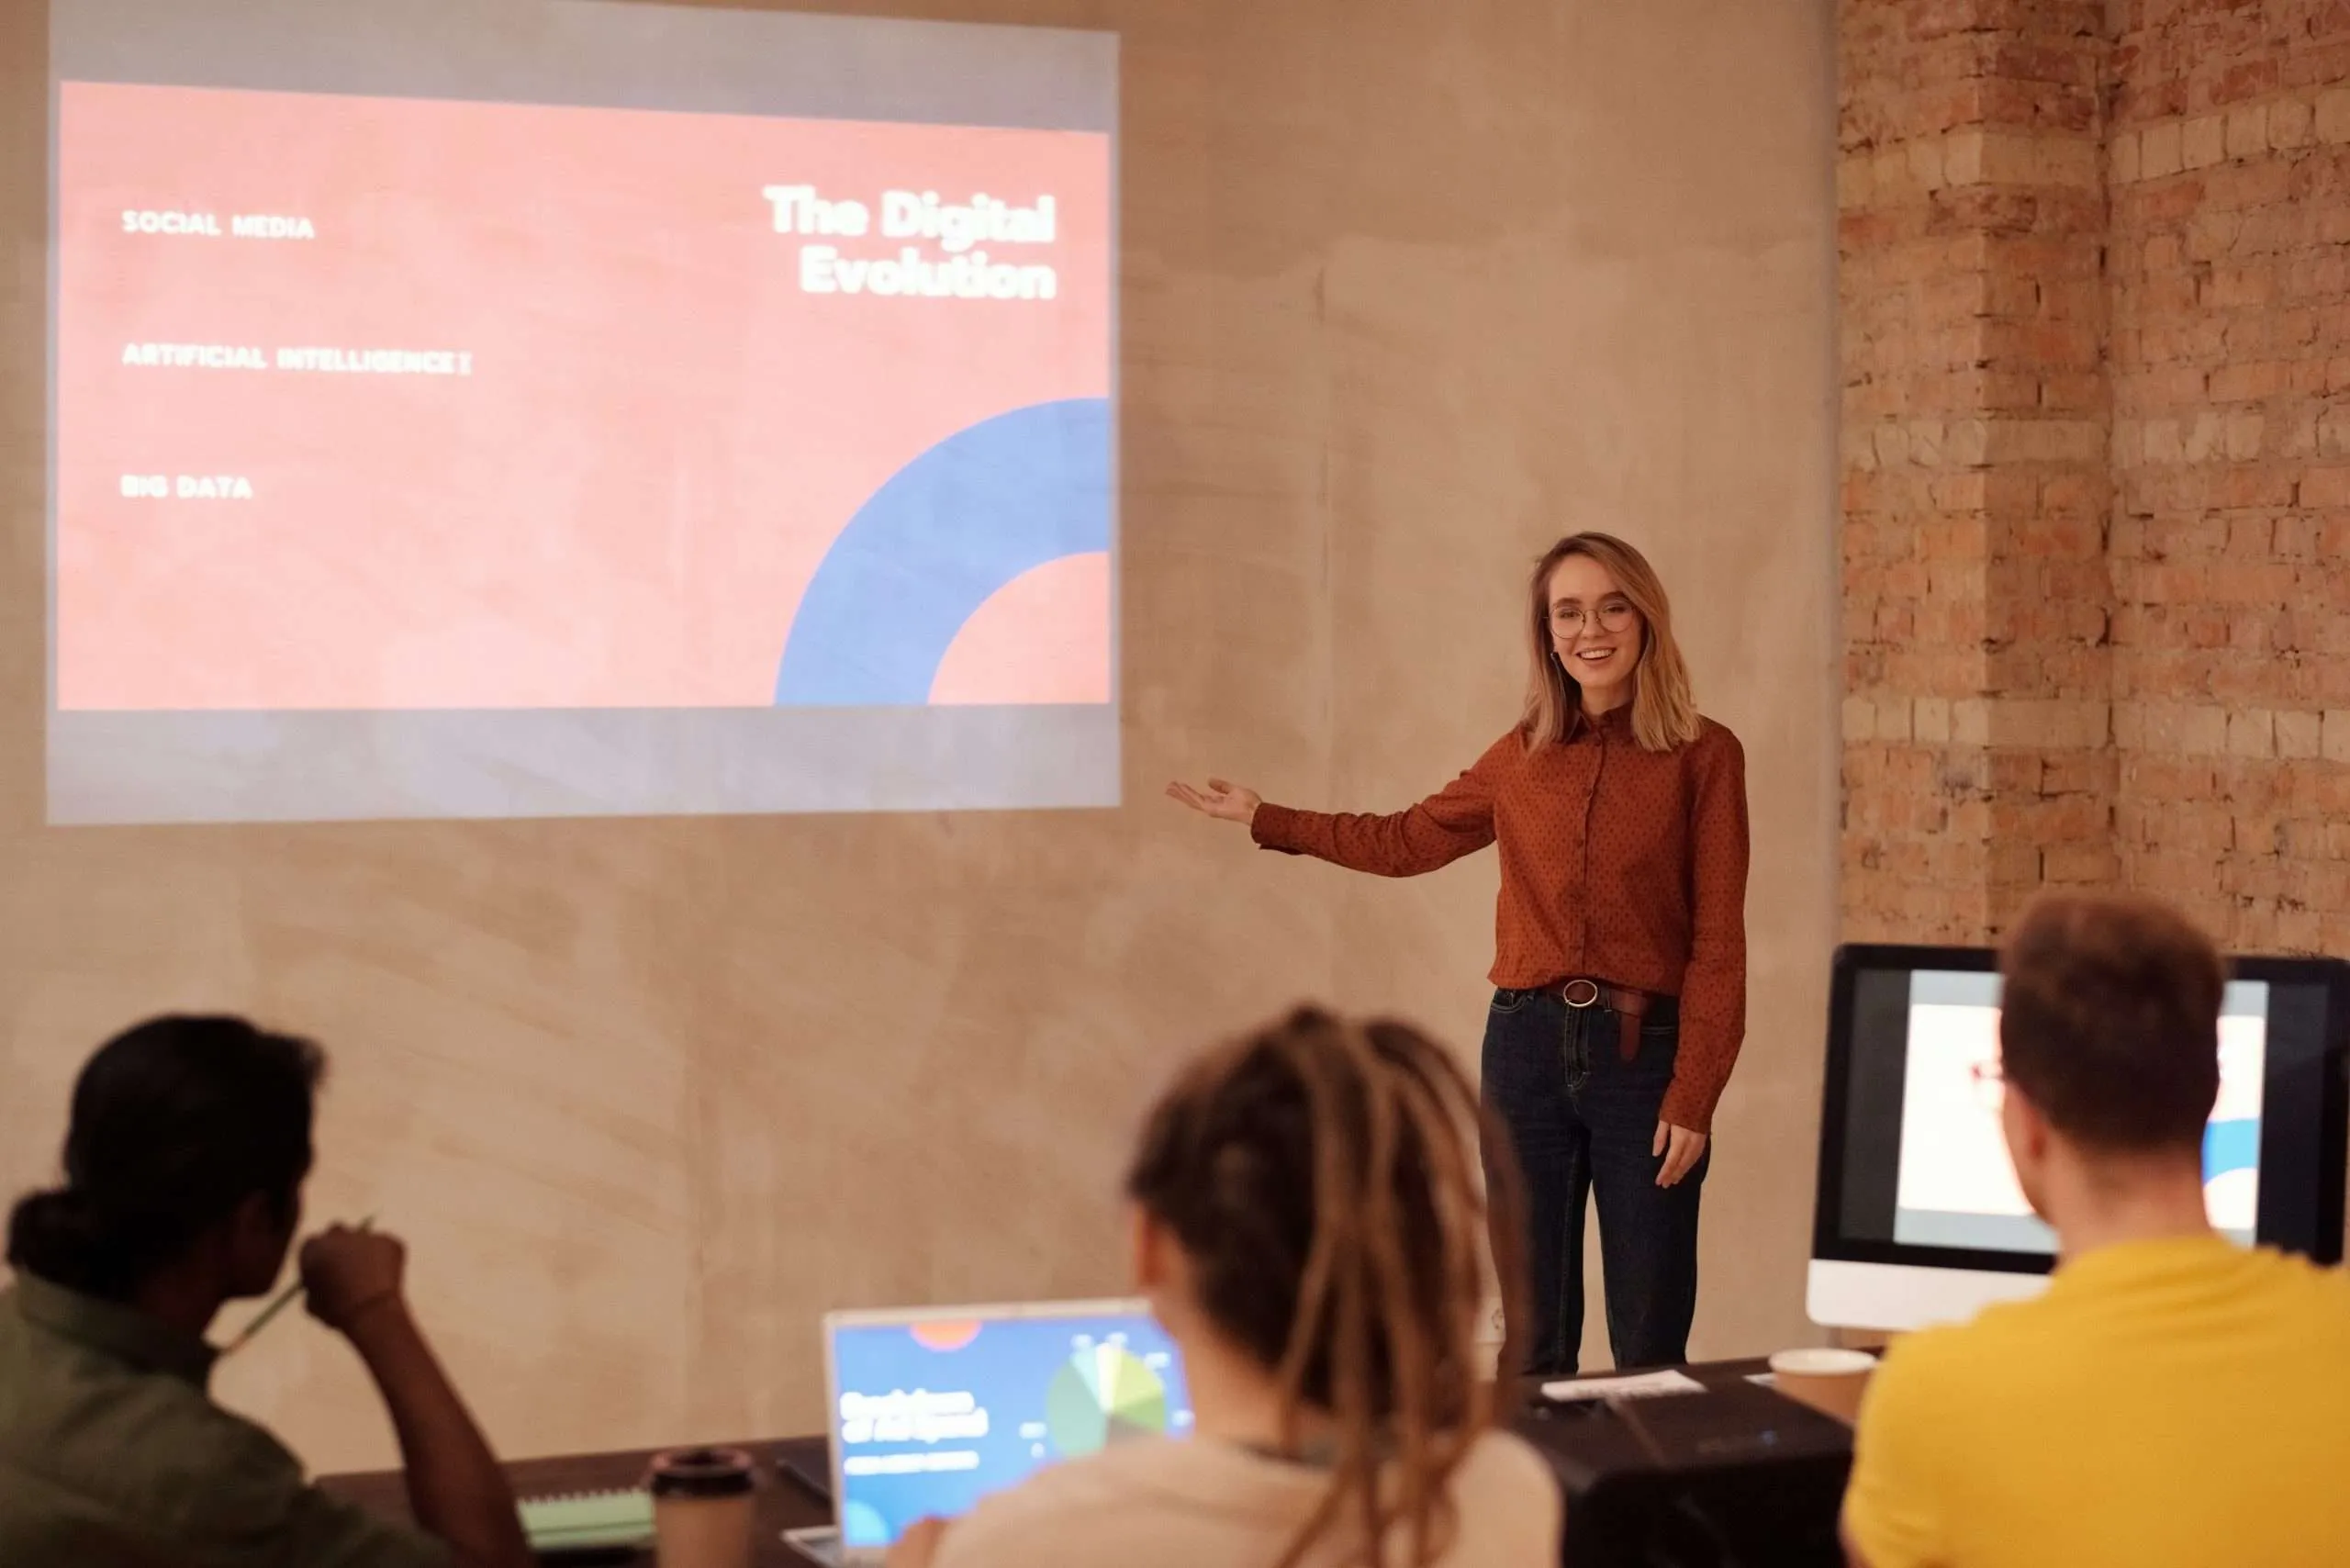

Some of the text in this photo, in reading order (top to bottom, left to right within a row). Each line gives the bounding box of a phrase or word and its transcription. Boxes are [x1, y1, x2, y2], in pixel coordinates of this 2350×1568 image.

[122, 210, 315, 240] SOCIAL MEDIA
[762, 185, 1056, 252] The Digital
[800, 244, 1058, 299] Evolution
[122, 342, 267, 369] ARTIFICIAL
[120, 474, 252, 499] BIG DATA
